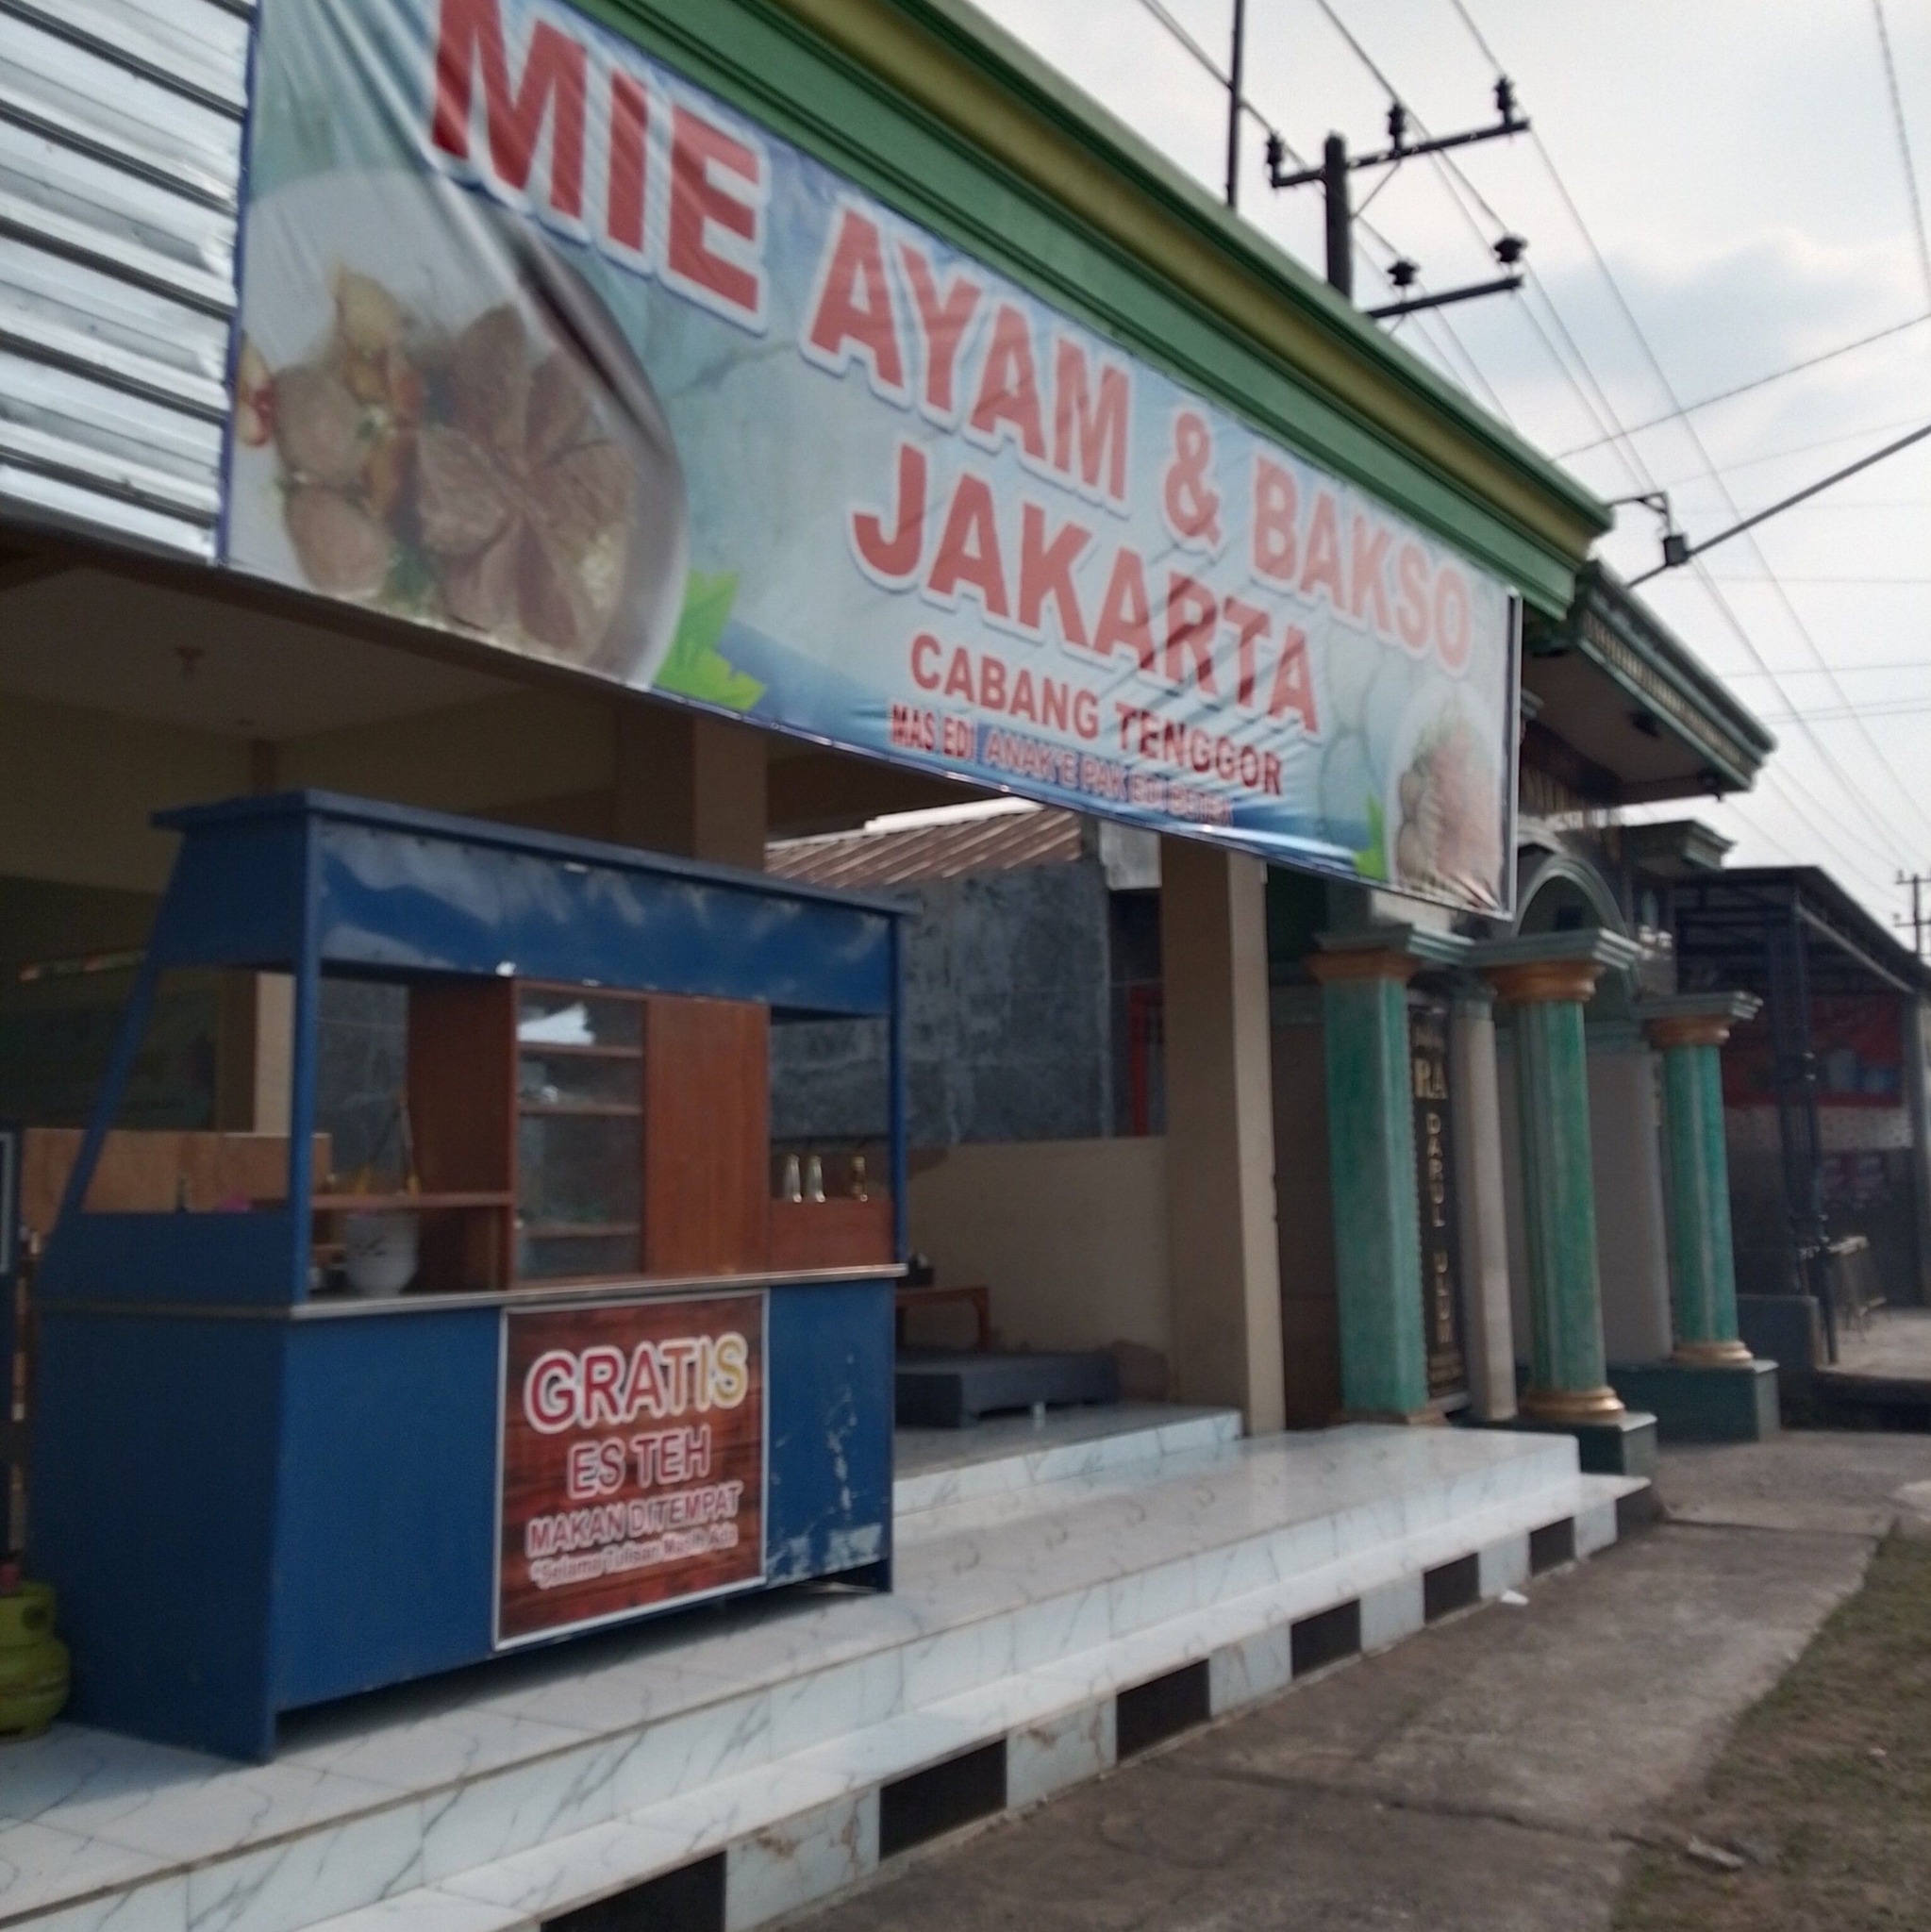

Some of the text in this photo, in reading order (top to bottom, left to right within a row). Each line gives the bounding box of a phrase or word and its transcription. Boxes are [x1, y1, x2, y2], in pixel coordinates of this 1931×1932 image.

[431, 0, 1473, 668] MIE AYAM & BAKSO
[851, 442, 1320, 733] JAKARTA
[891, 704, 934, 752] MAS
[943, 715, 976, 762] EDI
[909, 633, 1282, 796] CABANG TENGGOR
[524, 1332, 749, 1433] GRATIS
[568, 1424, 711, 1500] ES TEH
[526, 1500, 627, 1557] MAKAN
